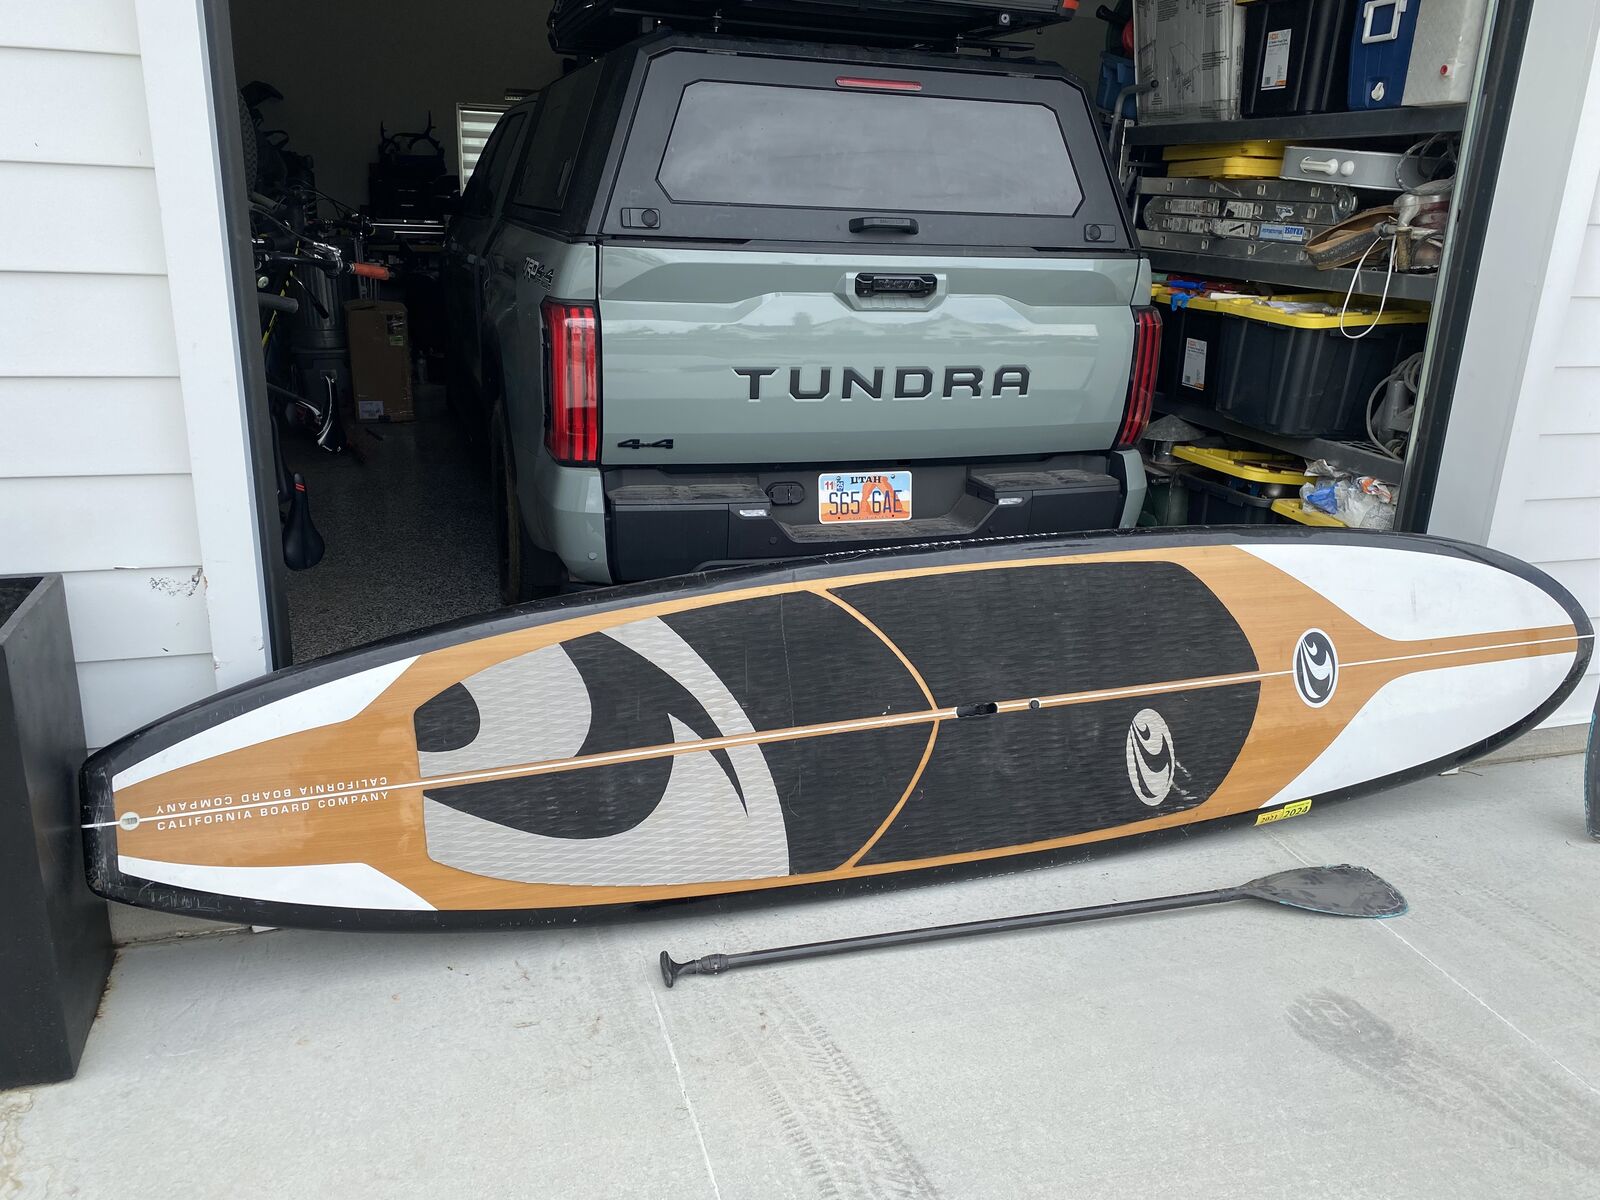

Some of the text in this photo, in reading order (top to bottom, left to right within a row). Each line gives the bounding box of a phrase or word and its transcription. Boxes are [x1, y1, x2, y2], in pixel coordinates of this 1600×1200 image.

[732, 365, 1031, 401] TUNDRA
[825, 481, 835, 491] 11
[850, 475, 882, 485] UTAH
[829, 489, 903, 516] S65 6AE
[156, 776, 387, 814] CALIFORNIA BOARD COMPANY
[157, 791, 388, 831] CALIFORNIA BOARD COMPANY
[1284, 806, 1308, 818] 2024
